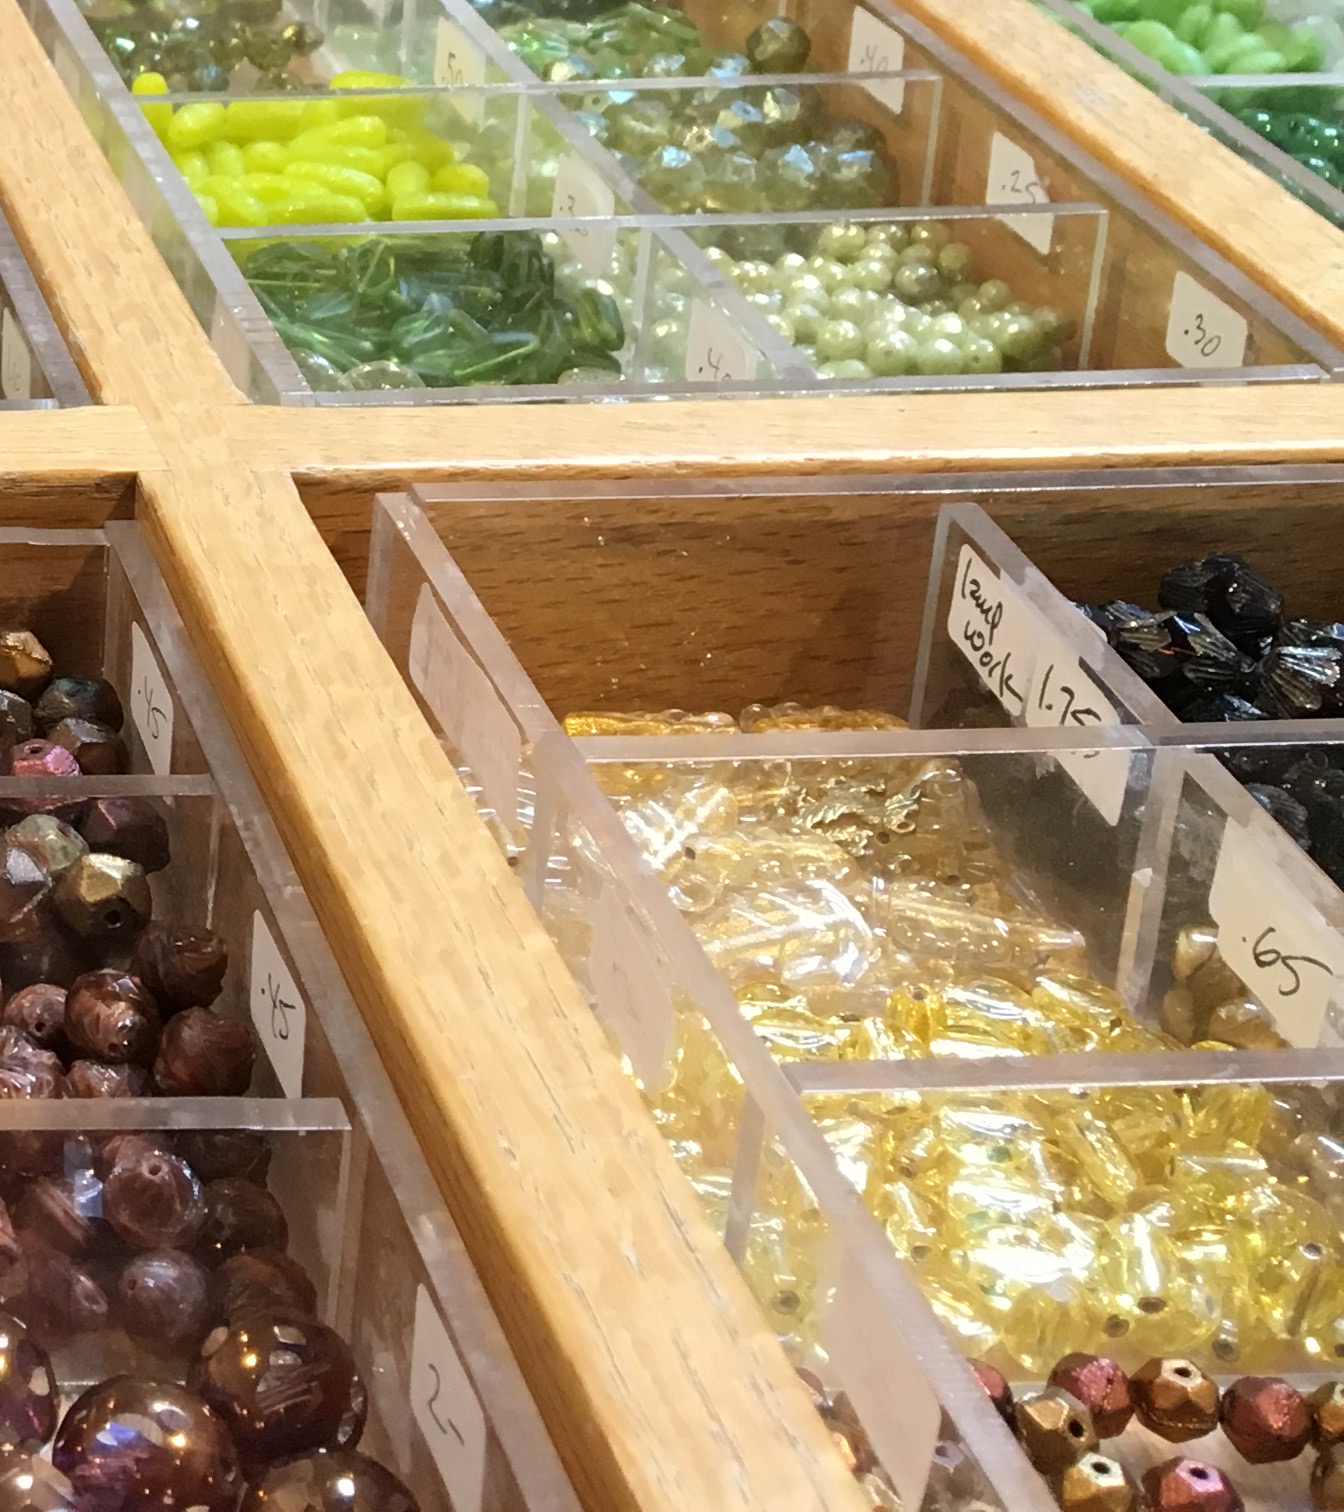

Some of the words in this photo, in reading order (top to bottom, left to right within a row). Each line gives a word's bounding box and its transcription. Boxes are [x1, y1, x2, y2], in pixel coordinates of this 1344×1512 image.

[1183, 313, 1222, 357] .30
[698, 347, 732, 381] .4
[1241, 926, 1334, 996] .65
